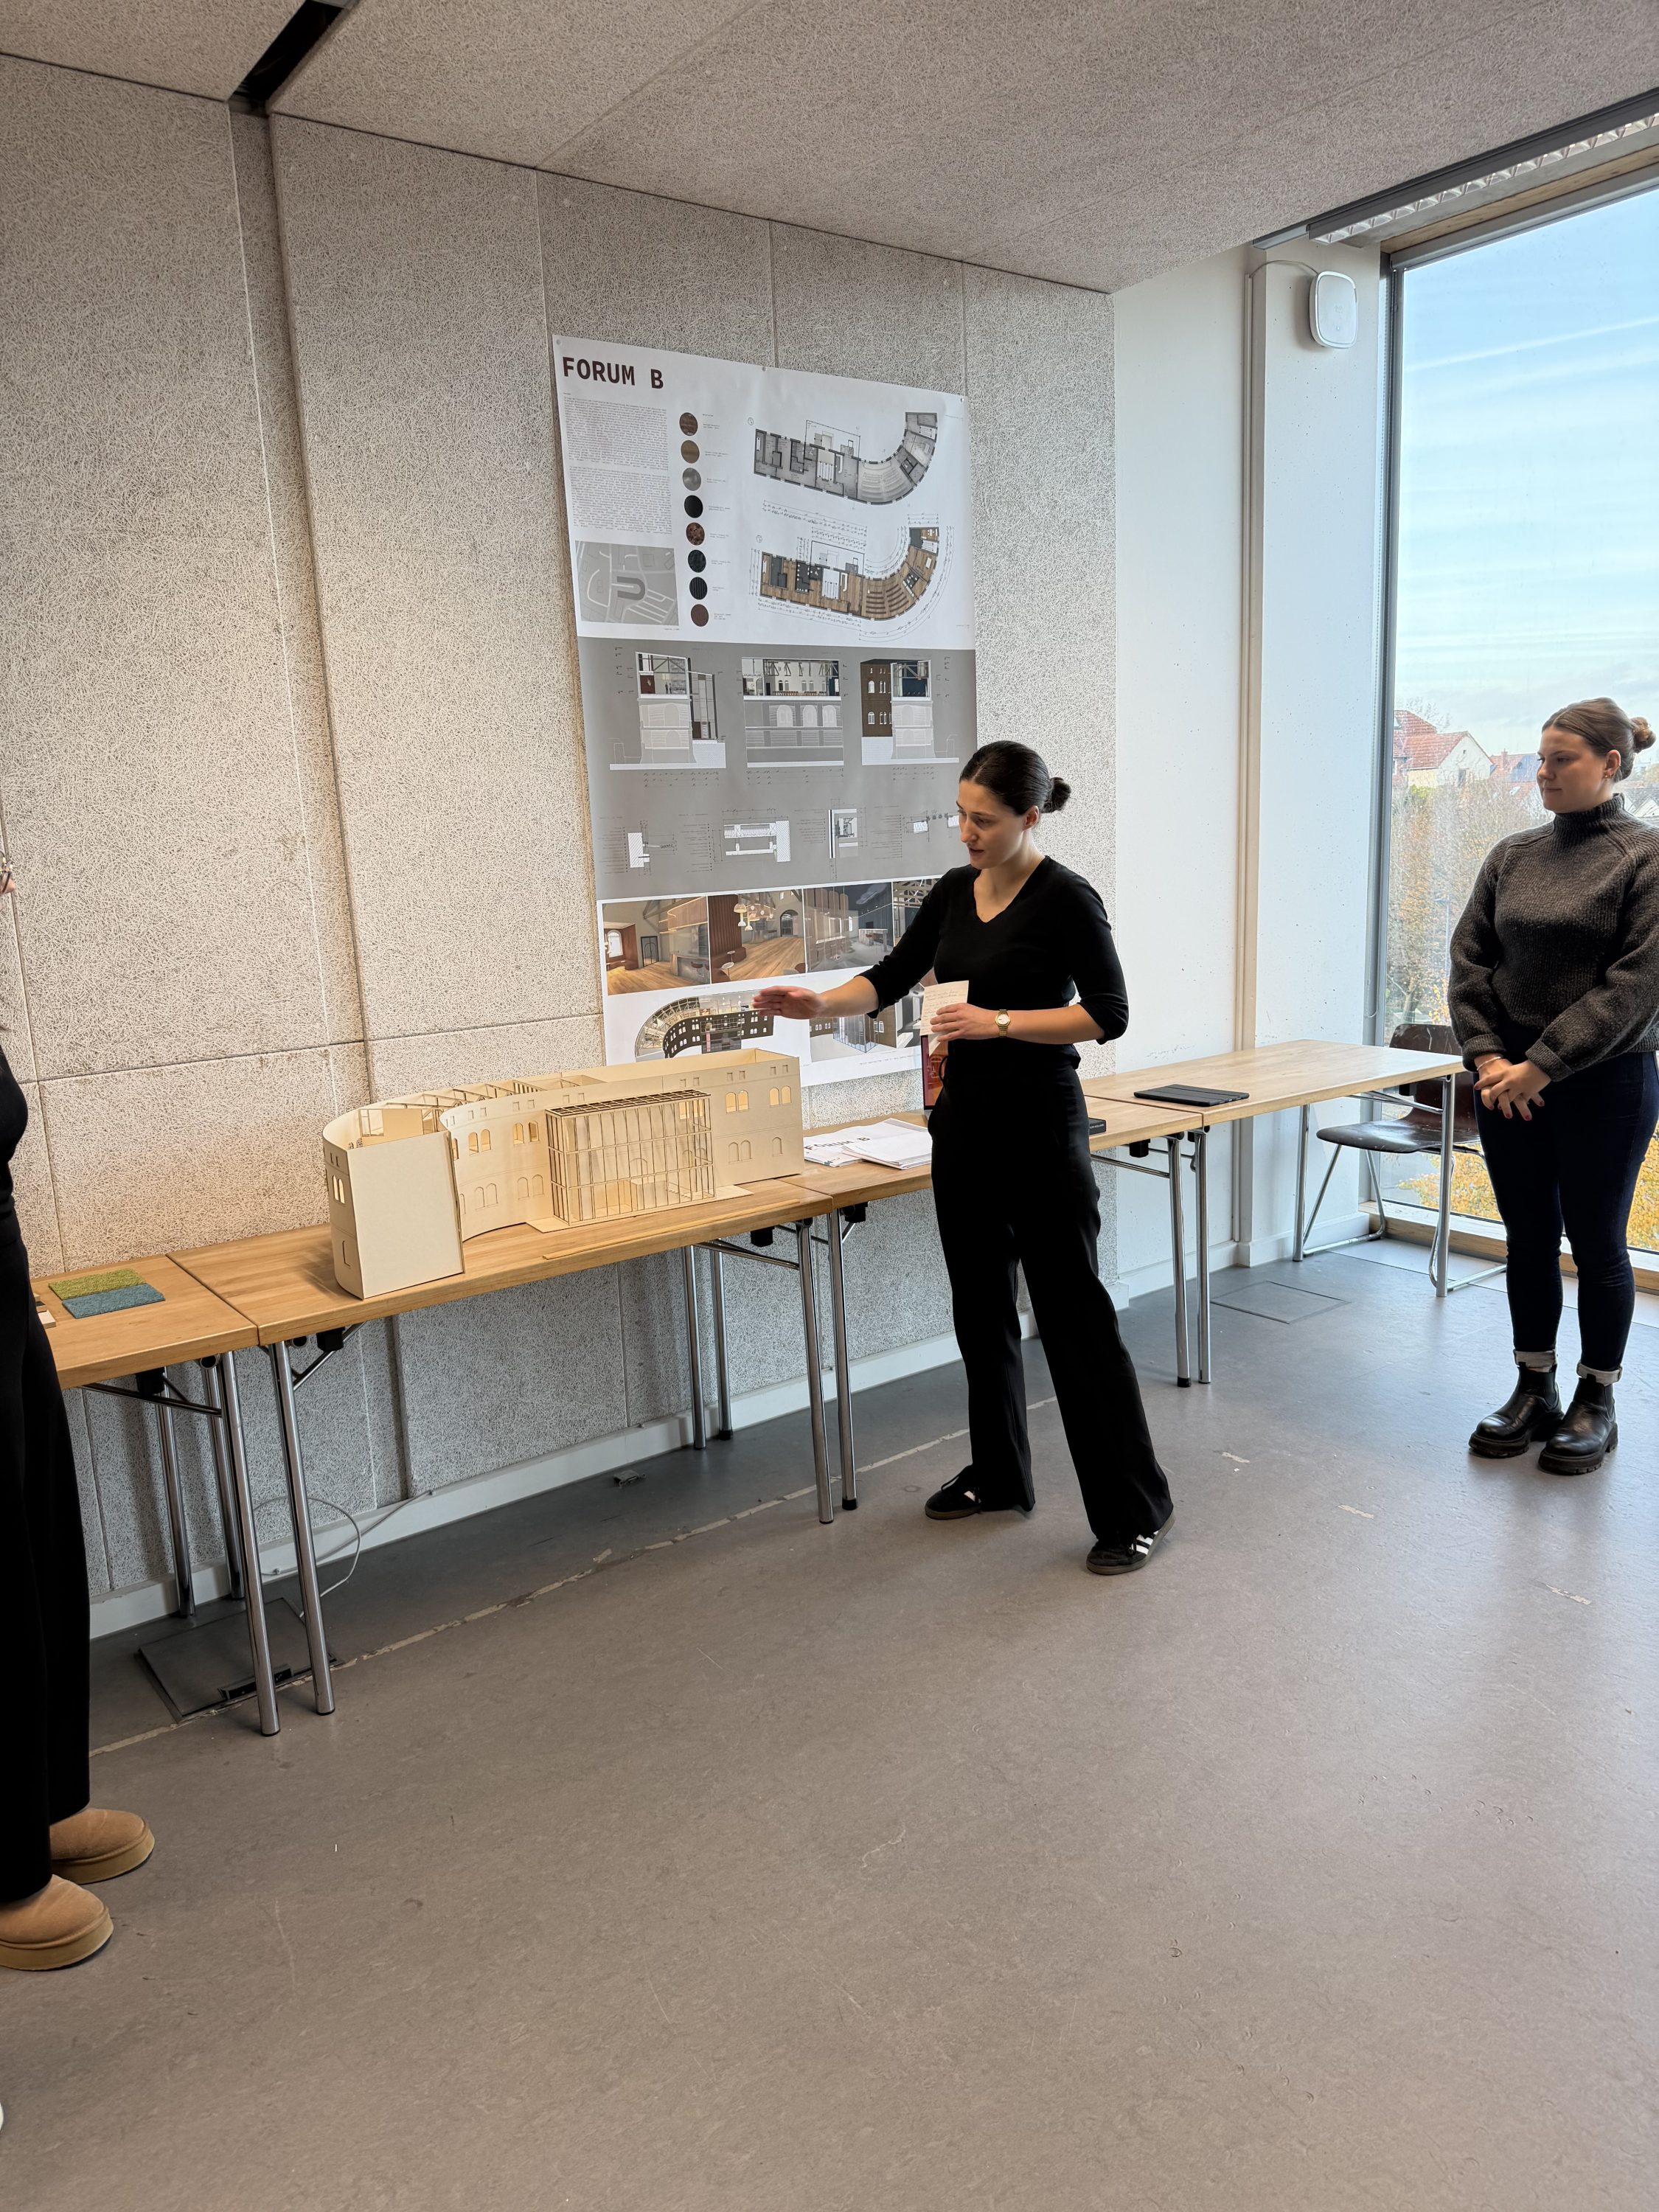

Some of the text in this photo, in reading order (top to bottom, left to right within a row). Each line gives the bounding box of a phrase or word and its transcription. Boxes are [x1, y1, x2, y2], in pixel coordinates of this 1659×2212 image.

[563, 357, 664, 389] FORUM B
[804, 1141, 854, 1150] FORUM
